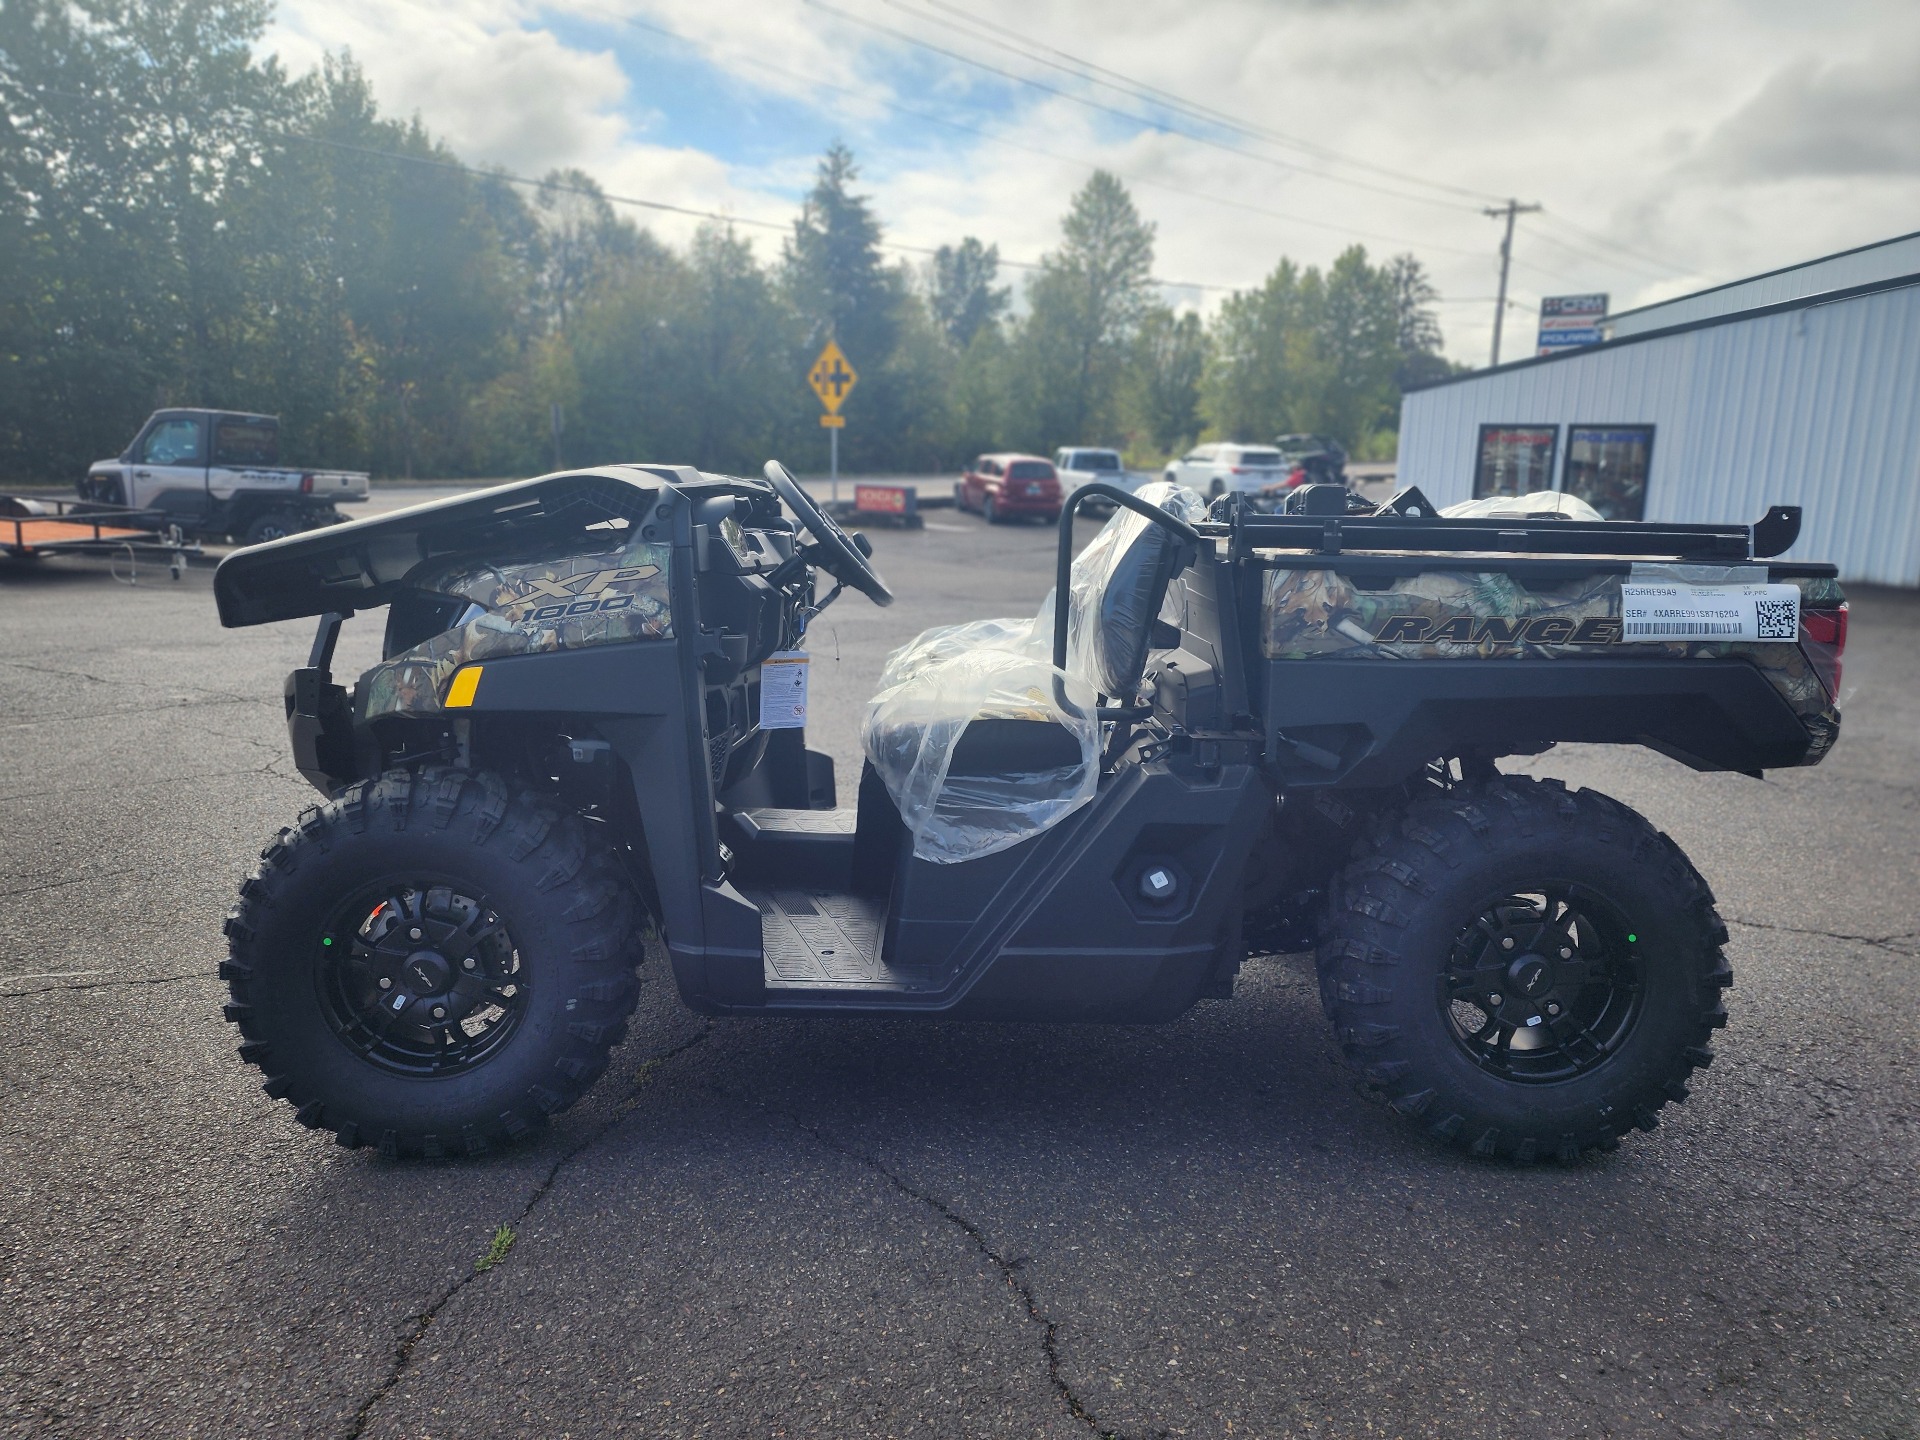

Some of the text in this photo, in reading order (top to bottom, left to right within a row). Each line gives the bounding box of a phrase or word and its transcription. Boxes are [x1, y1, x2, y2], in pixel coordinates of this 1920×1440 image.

[501, 564, 661, 606] XP
[1625, 587, 1677, 597] R25RRE99A9
[521, 594, 635, 622] 1000
[1626, 609, 1647, 618] SER#
[1372, 615, 1624, 644] RANGE
